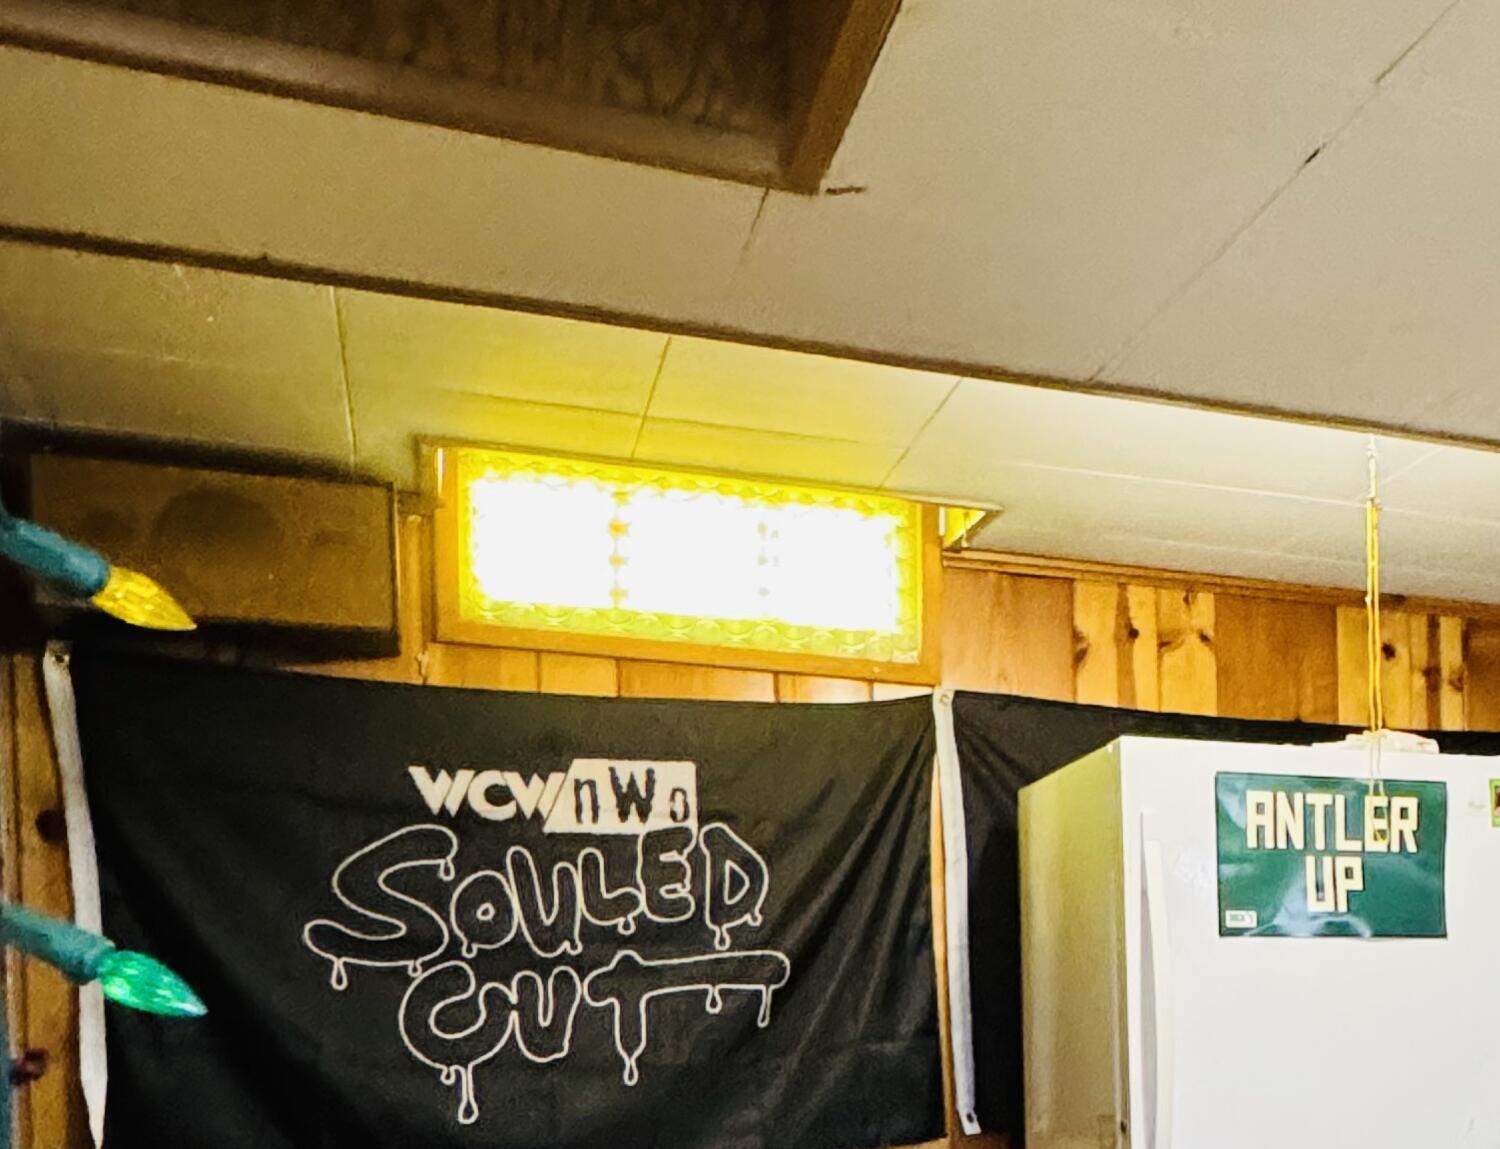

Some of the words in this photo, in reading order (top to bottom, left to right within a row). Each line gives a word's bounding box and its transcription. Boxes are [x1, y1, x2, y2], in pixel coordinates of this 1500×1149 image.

[407, 765, 566, 821] WCW
[1246, 789, 1419, 853] ANTLER
[303, 822, 769, 990] SOULED
[1305, 854, 1365, 913] UP
[399, 949, 791, 1124] OUT
